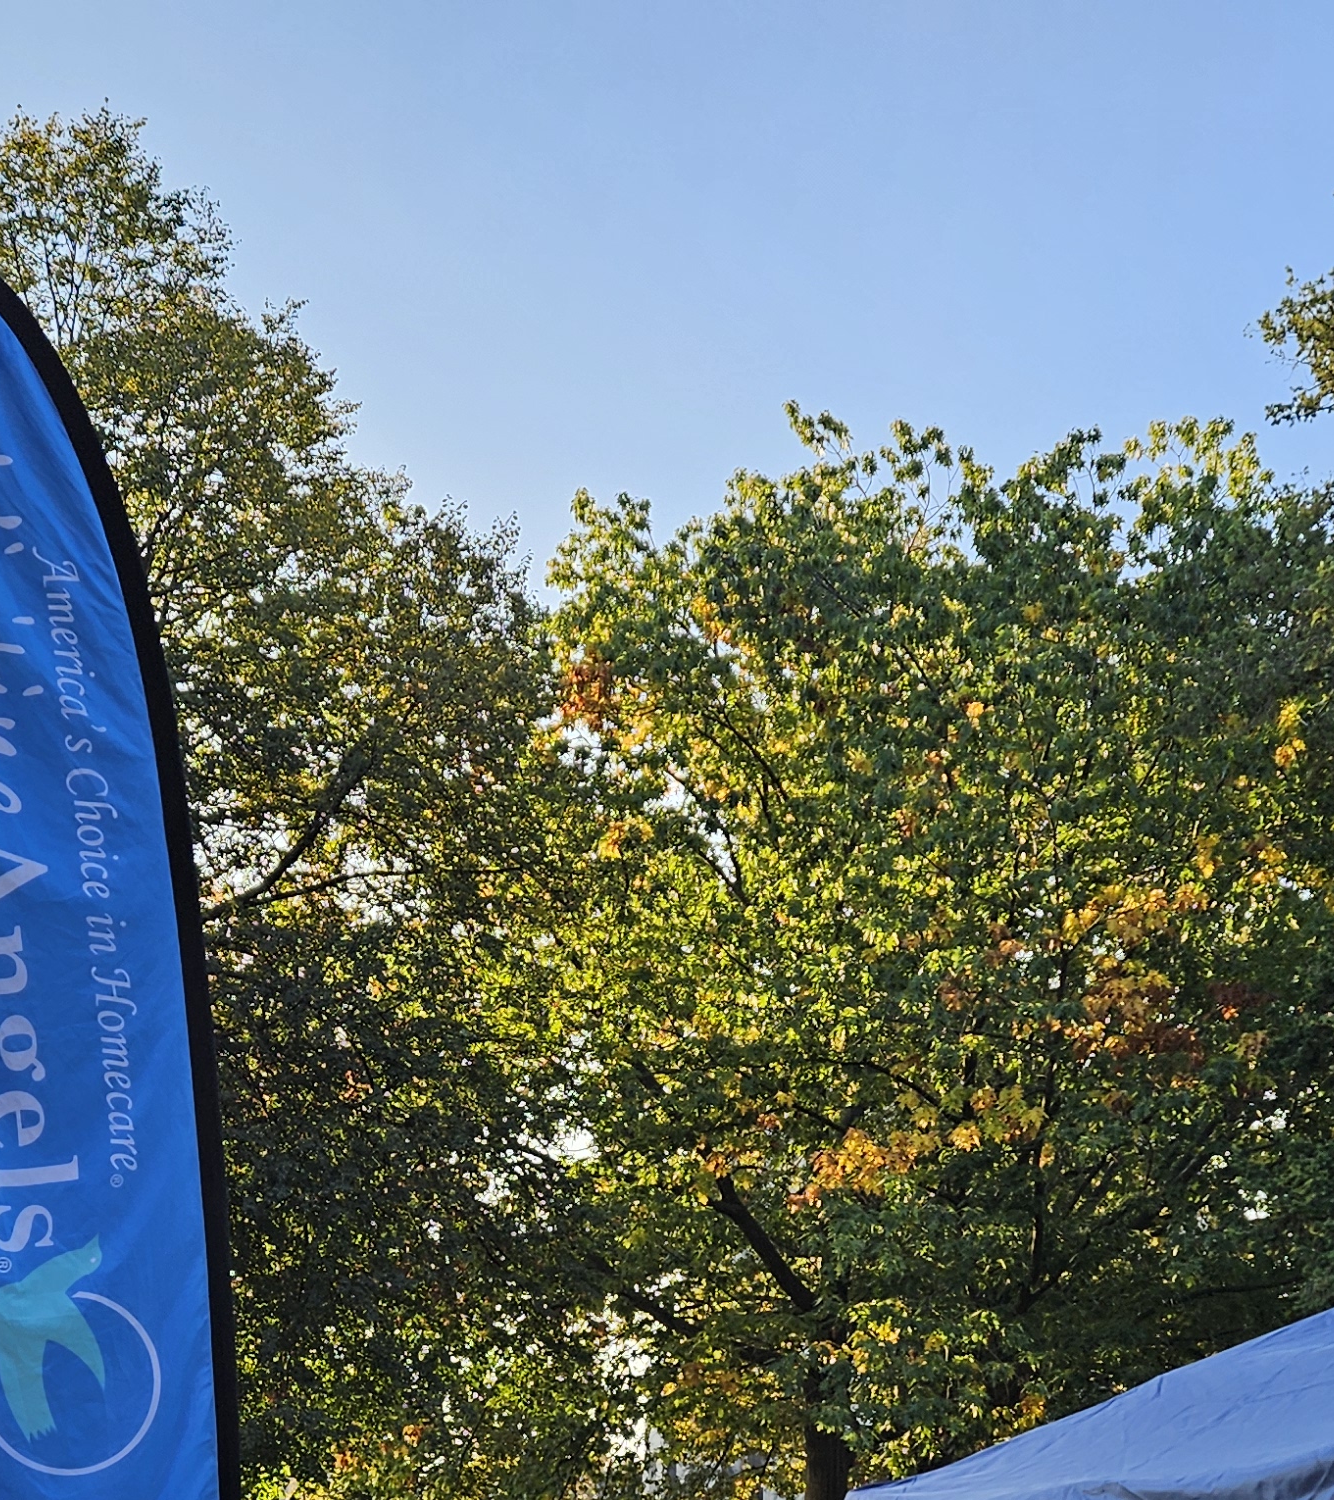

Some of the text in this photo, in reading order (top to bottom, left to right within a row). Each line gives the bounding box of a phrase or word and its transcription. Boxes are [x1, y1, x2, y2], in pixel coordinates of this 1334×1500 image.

[32, 546, 107, 754] America's
[65, 766, 120, 900] Choice
[84, 913, 127, 956] in
